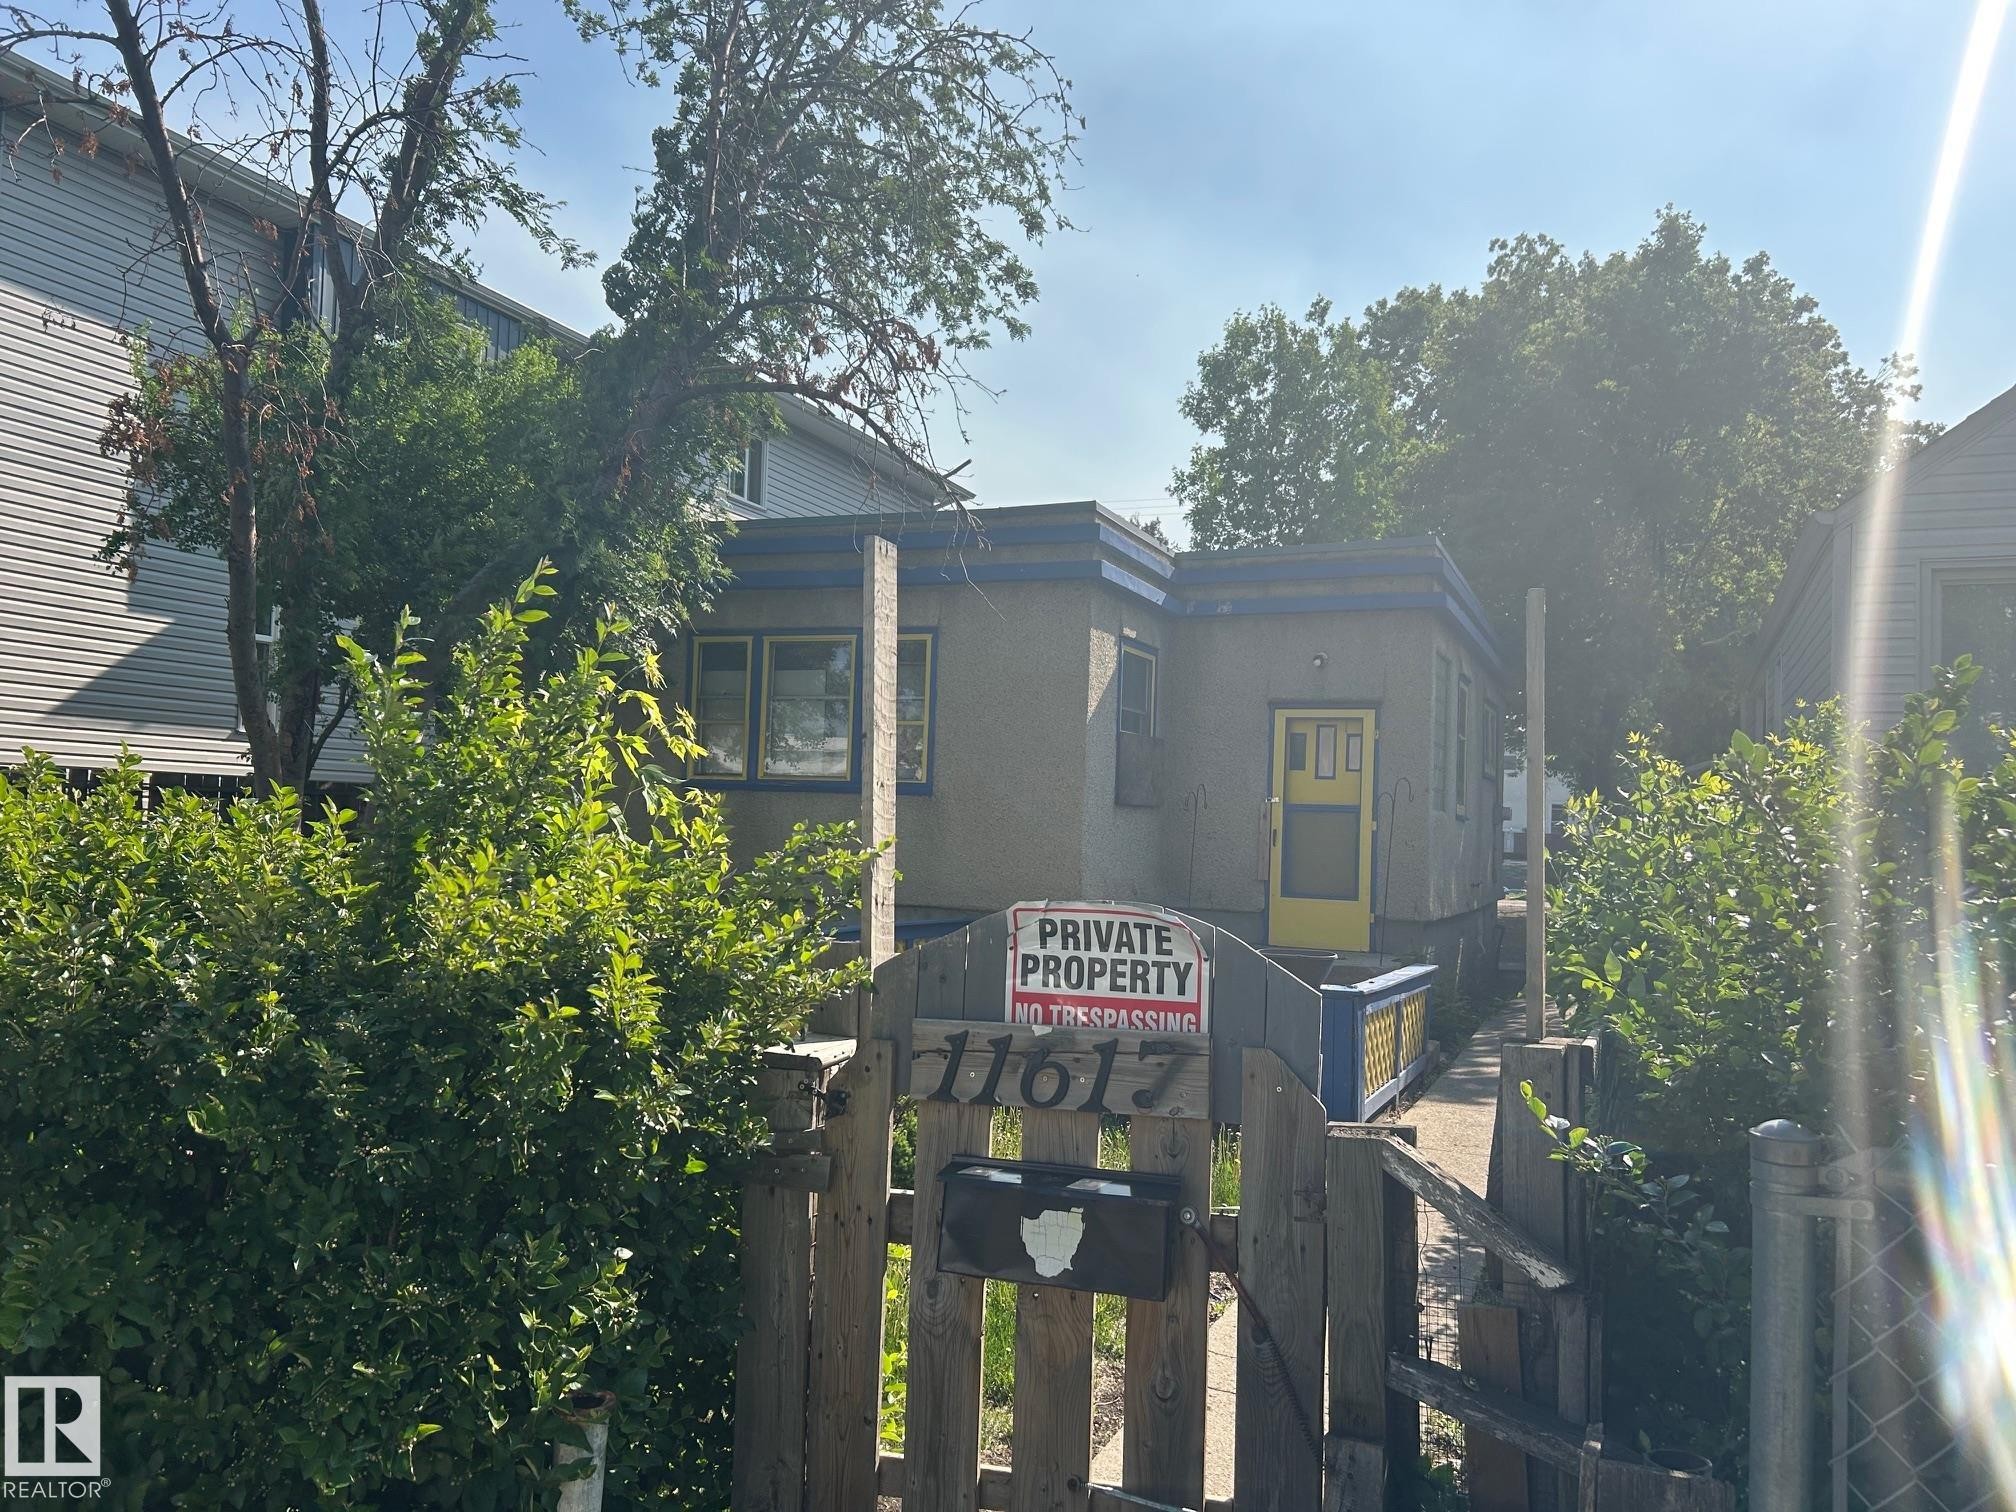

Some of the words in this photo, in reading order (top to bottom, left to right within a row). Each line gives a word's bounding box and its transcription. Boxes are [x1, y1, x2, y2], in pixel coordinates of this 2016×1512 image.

[1038, 918, 1173, 956] PRIVATE
[1020, 953, 1193, 996] PROPERTY
[1015, 1002, 1043, 1026] NO
[1050, 1004, 1197, 1032] TRESPASSING
[926, 1030, 1198, 1113] 11617
